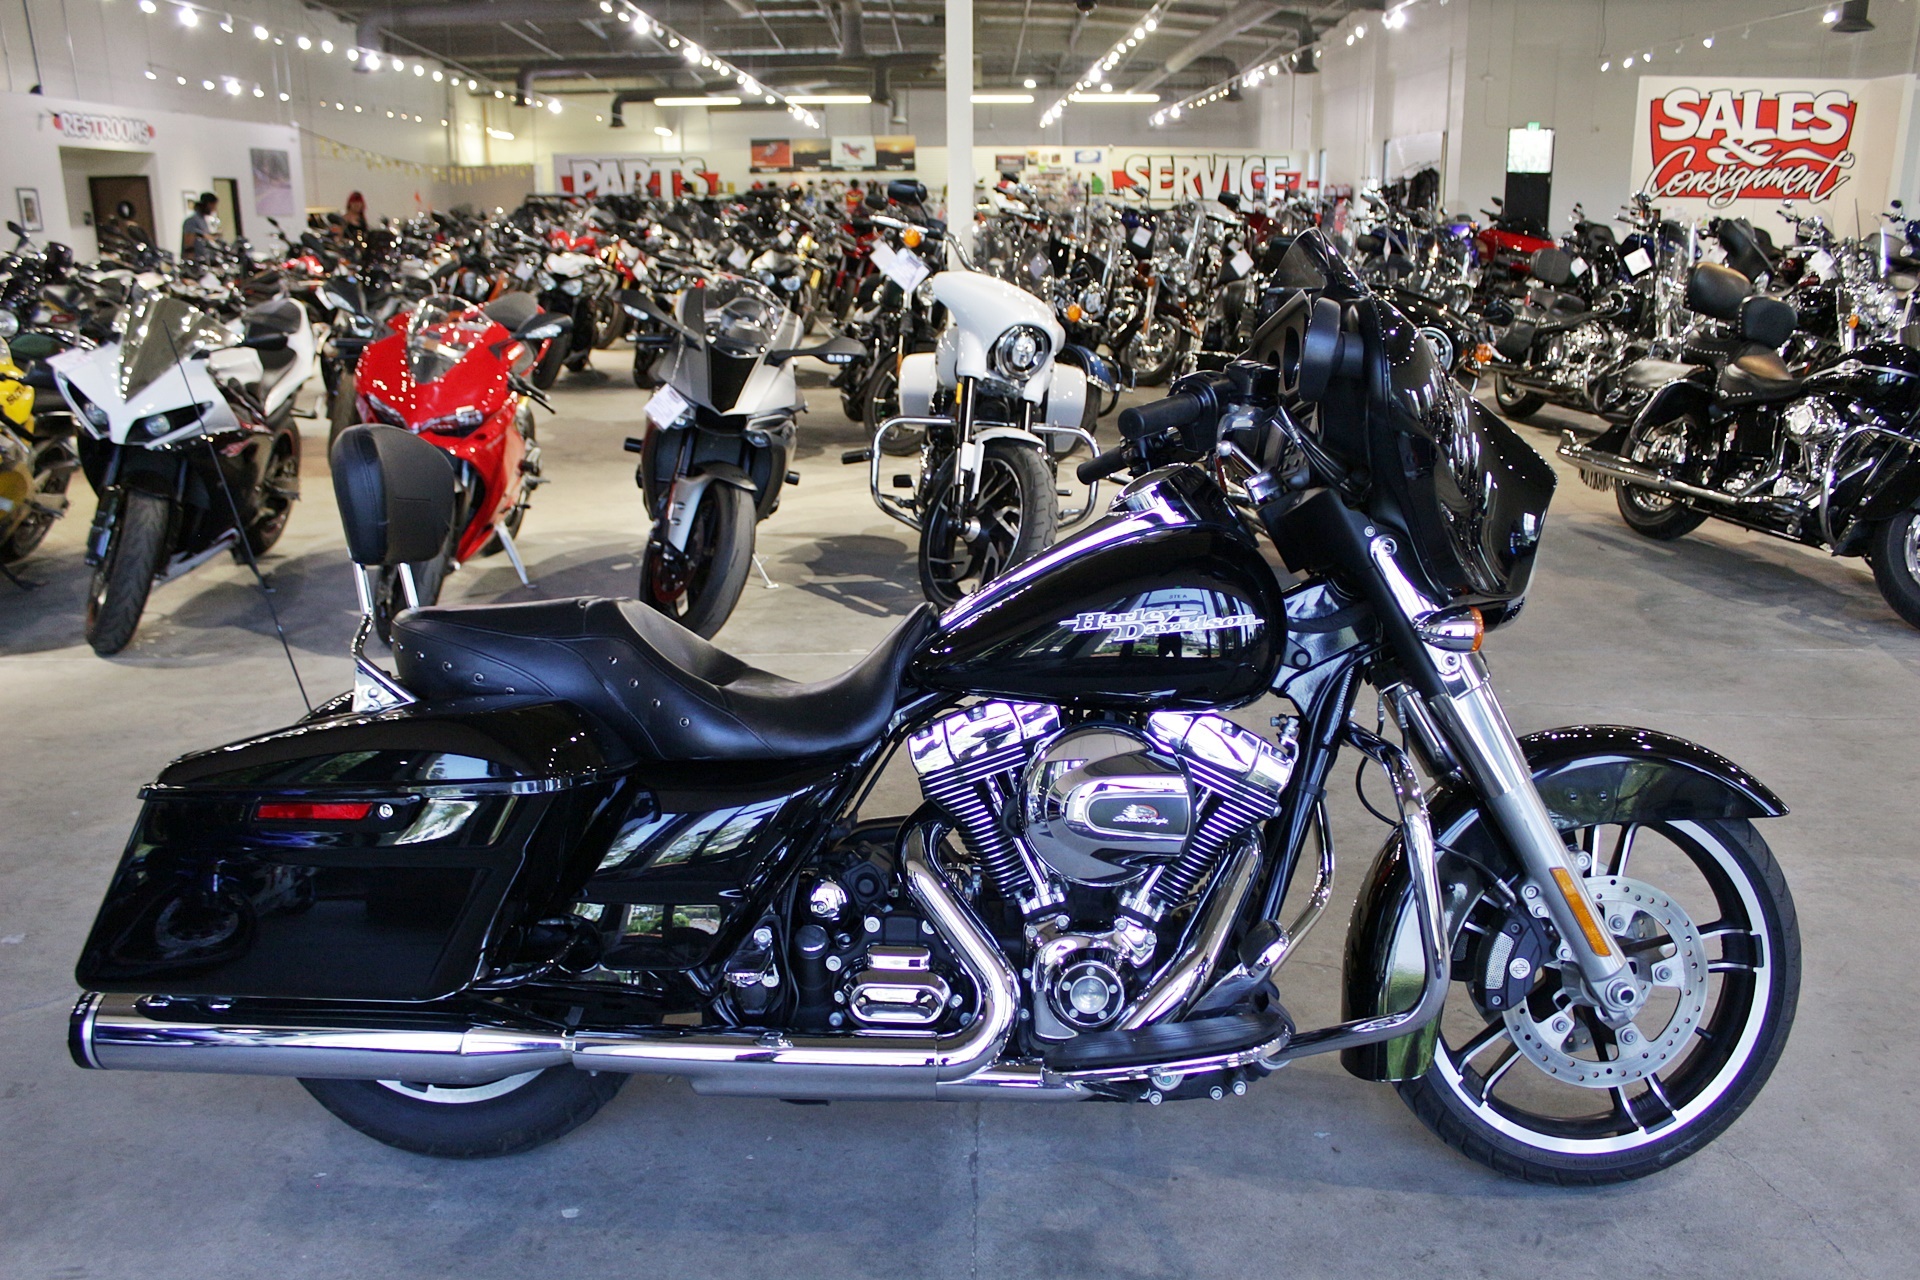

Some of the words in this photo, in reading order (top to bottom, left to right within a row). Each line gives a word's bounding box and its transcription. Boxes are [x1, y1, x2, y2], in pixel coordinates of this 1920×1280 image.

[60, 111, 150, 145] RESTROOMS
[1657, 86, 1850, 145] SALES
[1705, 136, 1783, 167] &
[569, 156, 710, 202] PARTS
[1124, 153, 1290, 217] SERVICE
[1642, 145, 1856, 210] Consignment
[1073, 607, 1198, 633] Harley
[1103, 613, 1265, 642] Davidson
